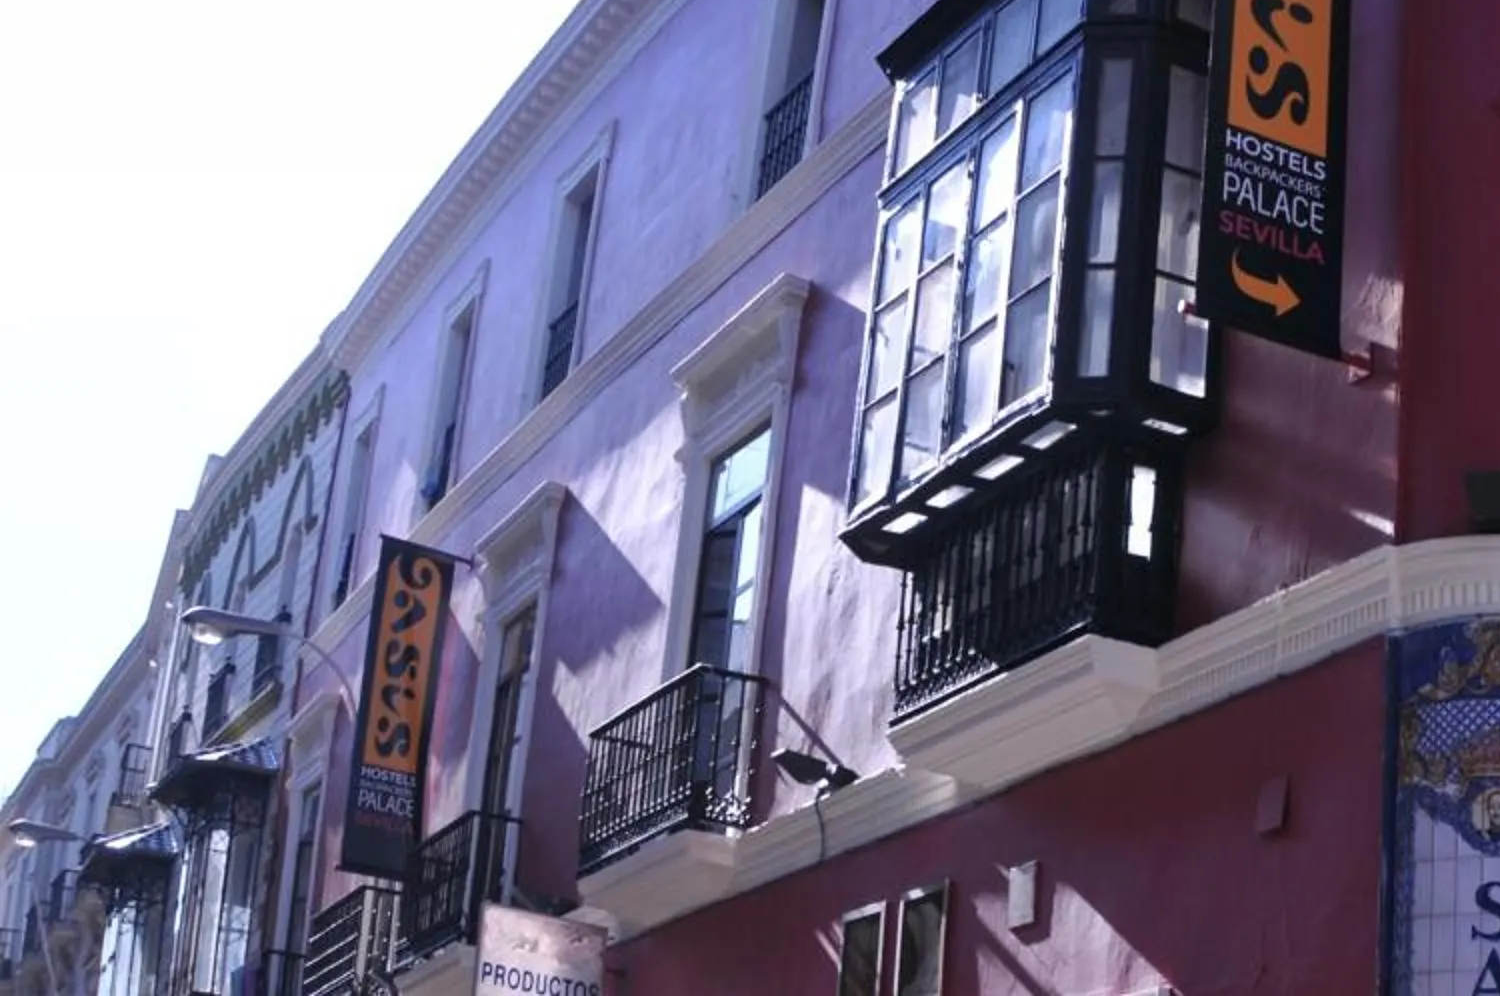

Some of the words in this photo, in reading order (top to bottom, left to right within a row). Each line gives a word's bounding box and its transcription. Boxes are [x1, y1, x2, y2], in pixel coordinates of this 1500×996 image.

[1225, 127, 1326, 181] HOSTELS
[1223, 171, 1325, 235] PALACE
[1218, 209, 1325, 266] SEVILLA
[358, 788, 414, 819] PALACE
[360, 765, 416, 788] HOSTELS
